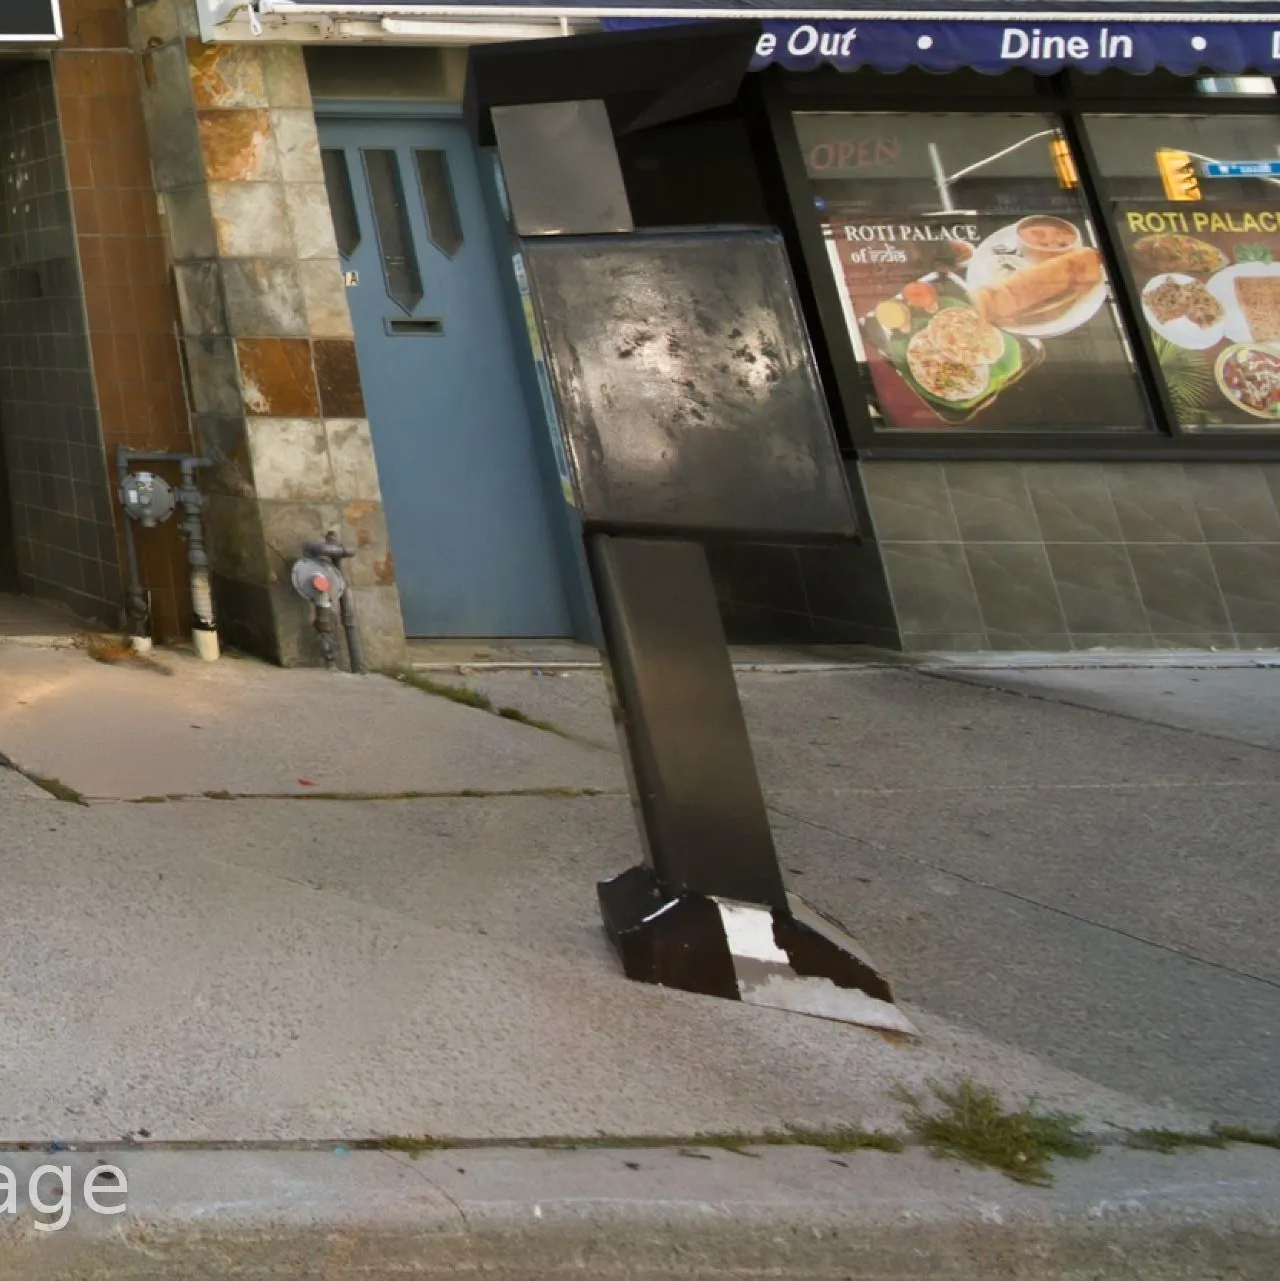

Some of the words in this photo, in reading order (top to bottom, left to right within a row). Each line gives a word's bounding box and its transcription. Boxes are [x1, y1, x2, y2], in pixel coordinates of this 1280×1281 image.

[787, 25, 857, 56] Out
[1000, 29, 1088, 59] Dine
[1100, 28, 1132, 58] In
[809, 137, 901, 171] OPEN
[844, 225, 895, 242] ROTI
[898, 224, 981, 241] PALACE
[1127, 211, 1189, 233] ROTI
[851, 247, 867, 264] of
